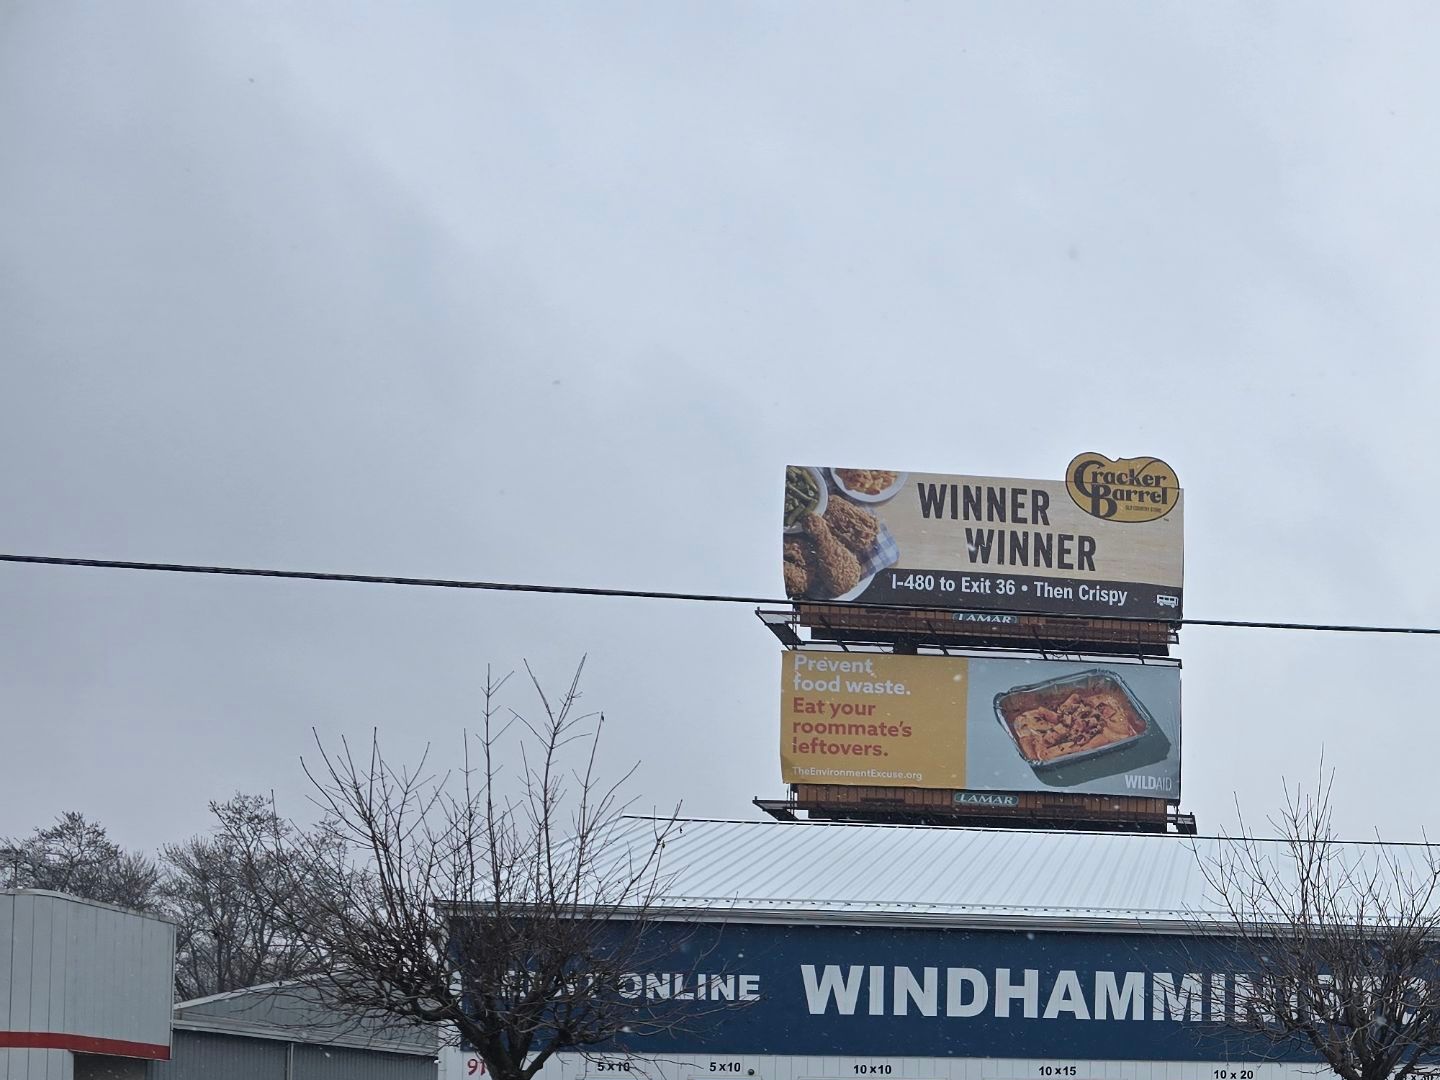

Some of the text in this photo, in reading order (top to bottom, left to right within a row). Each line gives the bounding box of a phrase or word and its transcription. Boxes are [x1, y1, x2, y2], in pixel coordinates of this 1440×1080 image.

[1074, 460, 1168, 498] Cracker
[917, 482, 1051, 527] WINNER
[1091, 482, 1168, 518] Barrel
[965, 527, 1097, 572] WINNER
[891, 573, 1128, 607] I-480 to Exit 36 Then Crispy
[793, 653, 874, 674] Prevent
[792, 674, 911, 696] food waste.
[793, 697, 876, 719] Eat your
[792, 720, 913, 738] roommate's
[792, 736, 889, 757] leftovers.
[792, 766, 923, 781] TheEnvironmentExcuse.org
[960, 793, 1013, 805] LAMAR
[617, 972, 761, 1002] ONLINE
